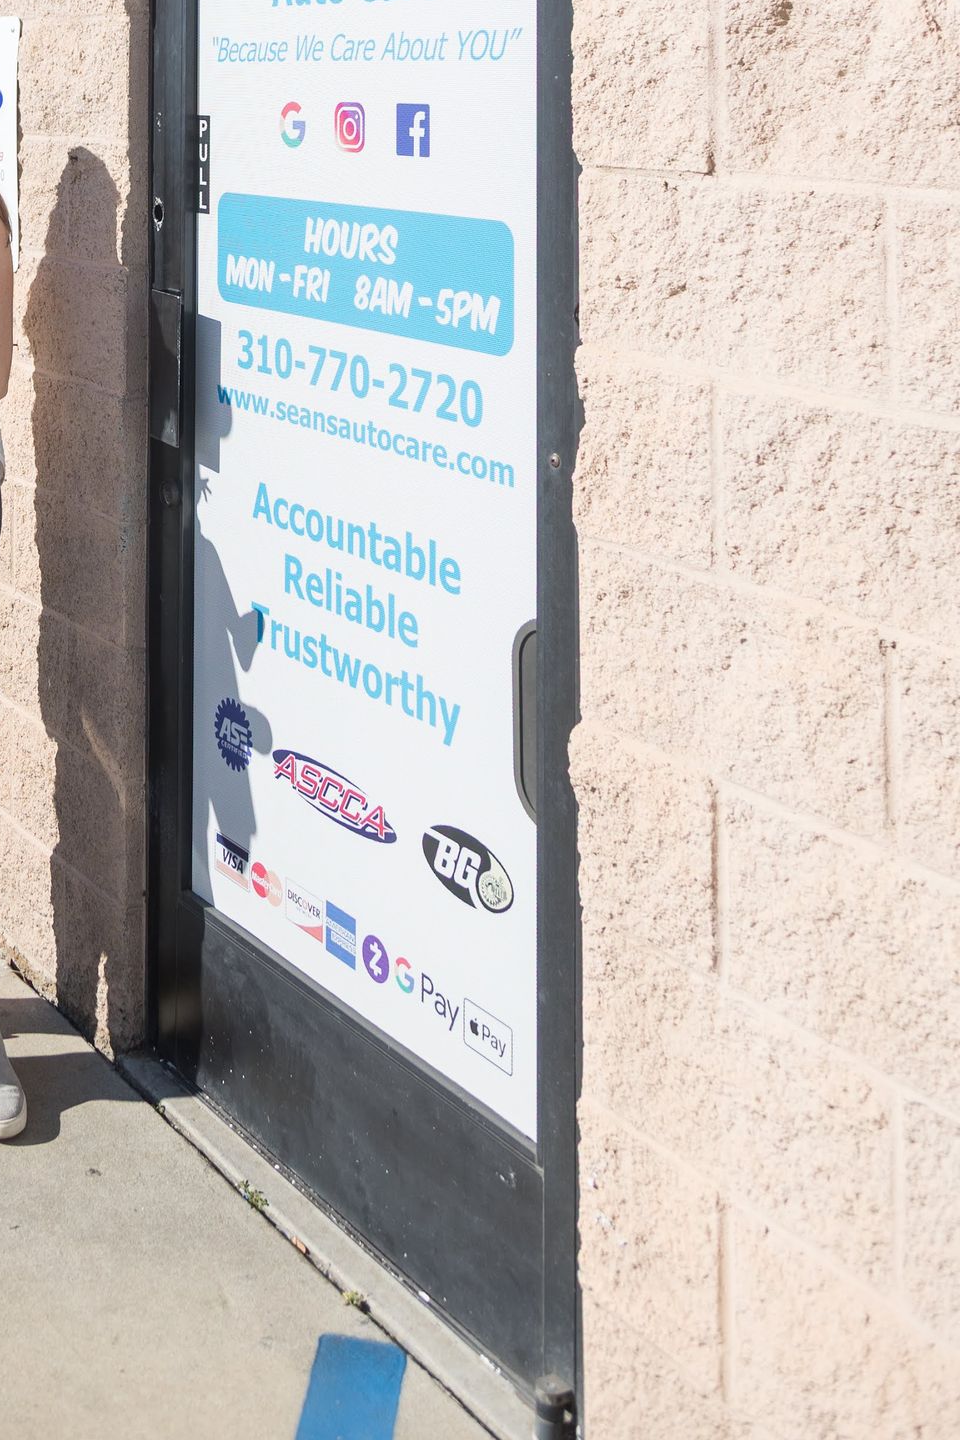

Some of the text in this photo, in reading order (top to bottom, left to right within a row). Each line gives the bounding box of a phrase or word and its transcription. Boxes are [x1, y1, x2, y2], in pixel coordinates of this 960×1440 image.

[212, 27, 523, 63] "Because We Care About YOU"
[198, 119, 208, 211] PULL
[303, 216, 399, 265] HOURS
[236, 330, 484, 428] 310-770-2720
[217, 385, 515, 488] www.seansautocare.com
[252, 482, 461, 595] Accountable
[284, 553, 419, 648] Reliable
[251, 601, 461, 747] Trustworthy
[219, 716, 248, 750] ASE
[273, 754, 393, 840] ASCCA
[222, 847, 244, 874] VISA
[433, 839, 482, 889] BG
[287, 889, 320, 919] DISCOVER
[421, 972, 459, 1031] Pay
[482, 1024, 506, 1058] Pay
